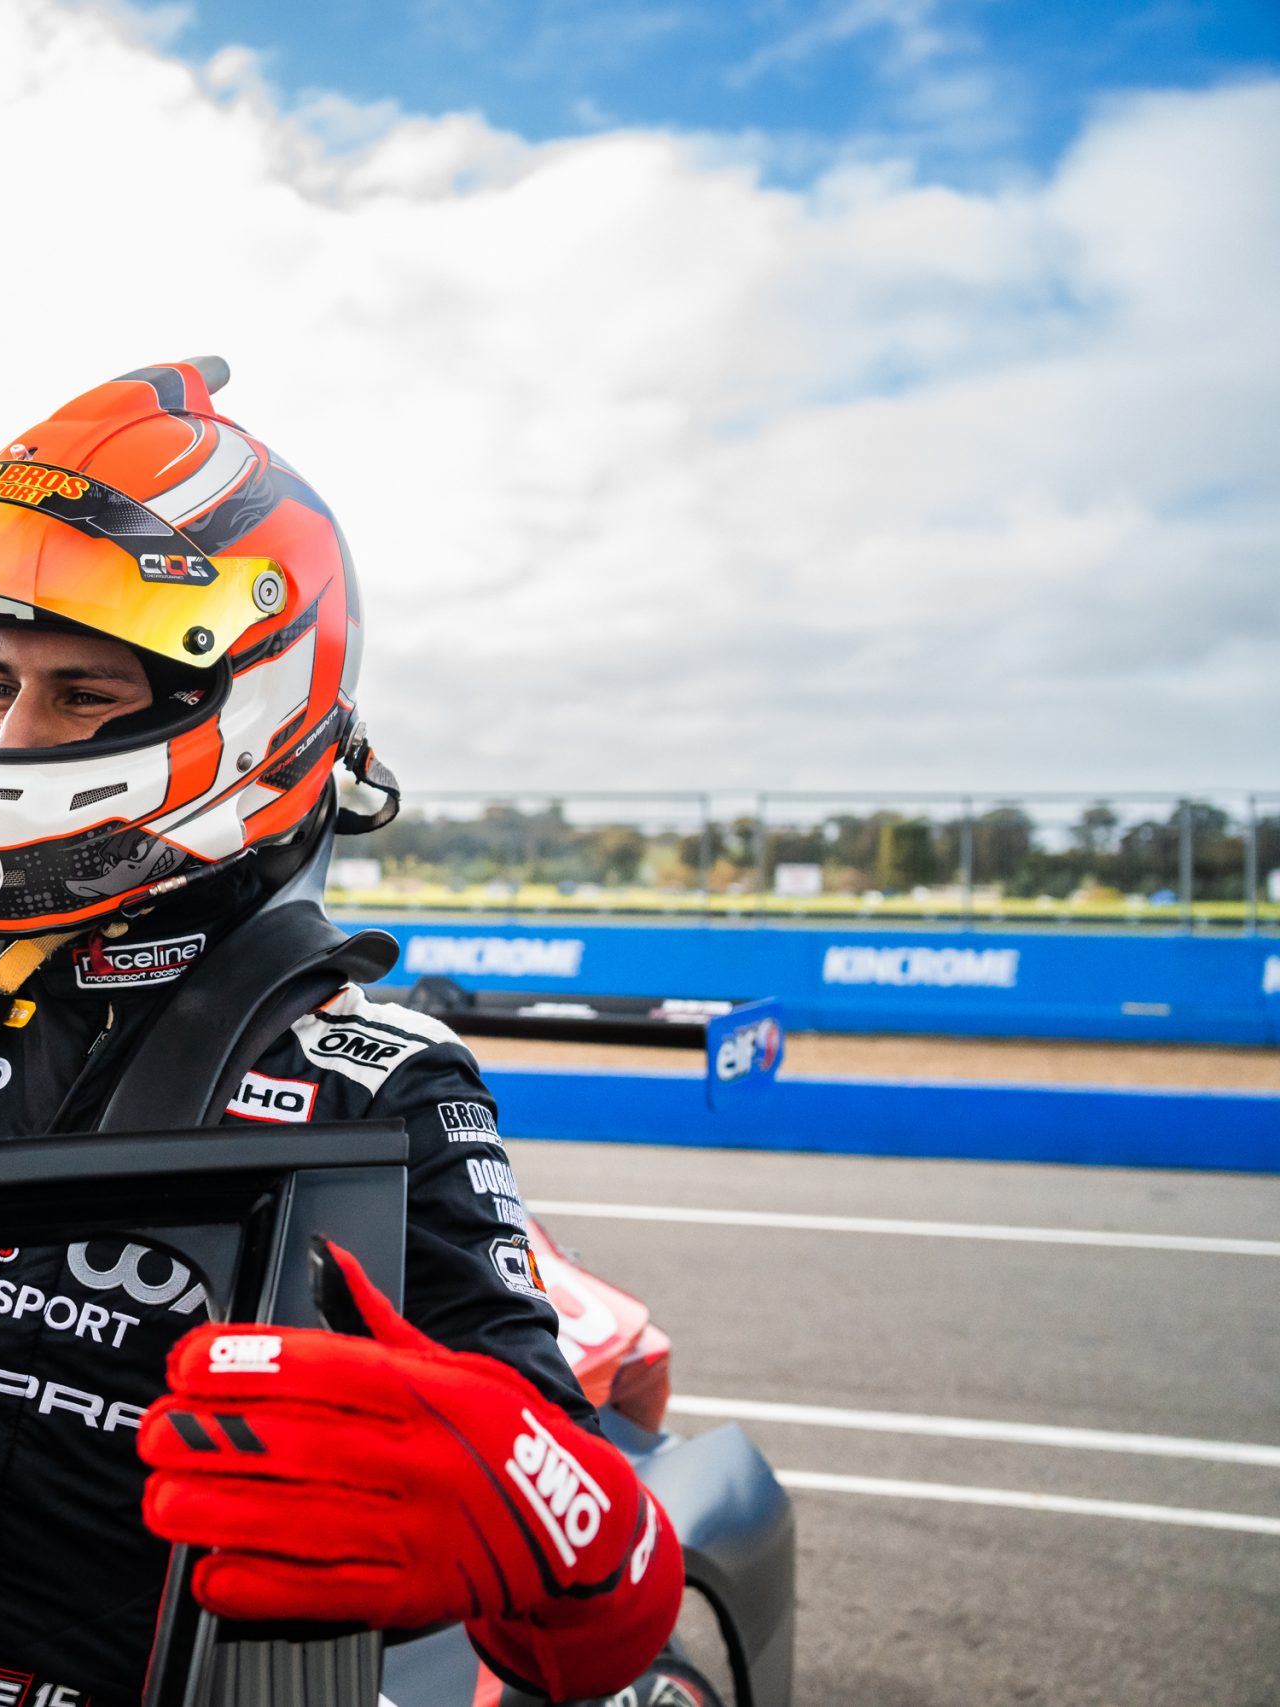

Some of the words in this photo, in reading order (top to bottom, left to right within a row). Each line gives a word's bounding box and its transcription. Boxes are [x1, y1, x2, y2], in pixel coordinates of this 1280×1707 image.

[317, 1032, 402, 1063] OMP
[716, 1026, 759, 1082] elf
[209, 1336, 282, 1363] OMP
[512, 1432, 602, 1548] OMP
